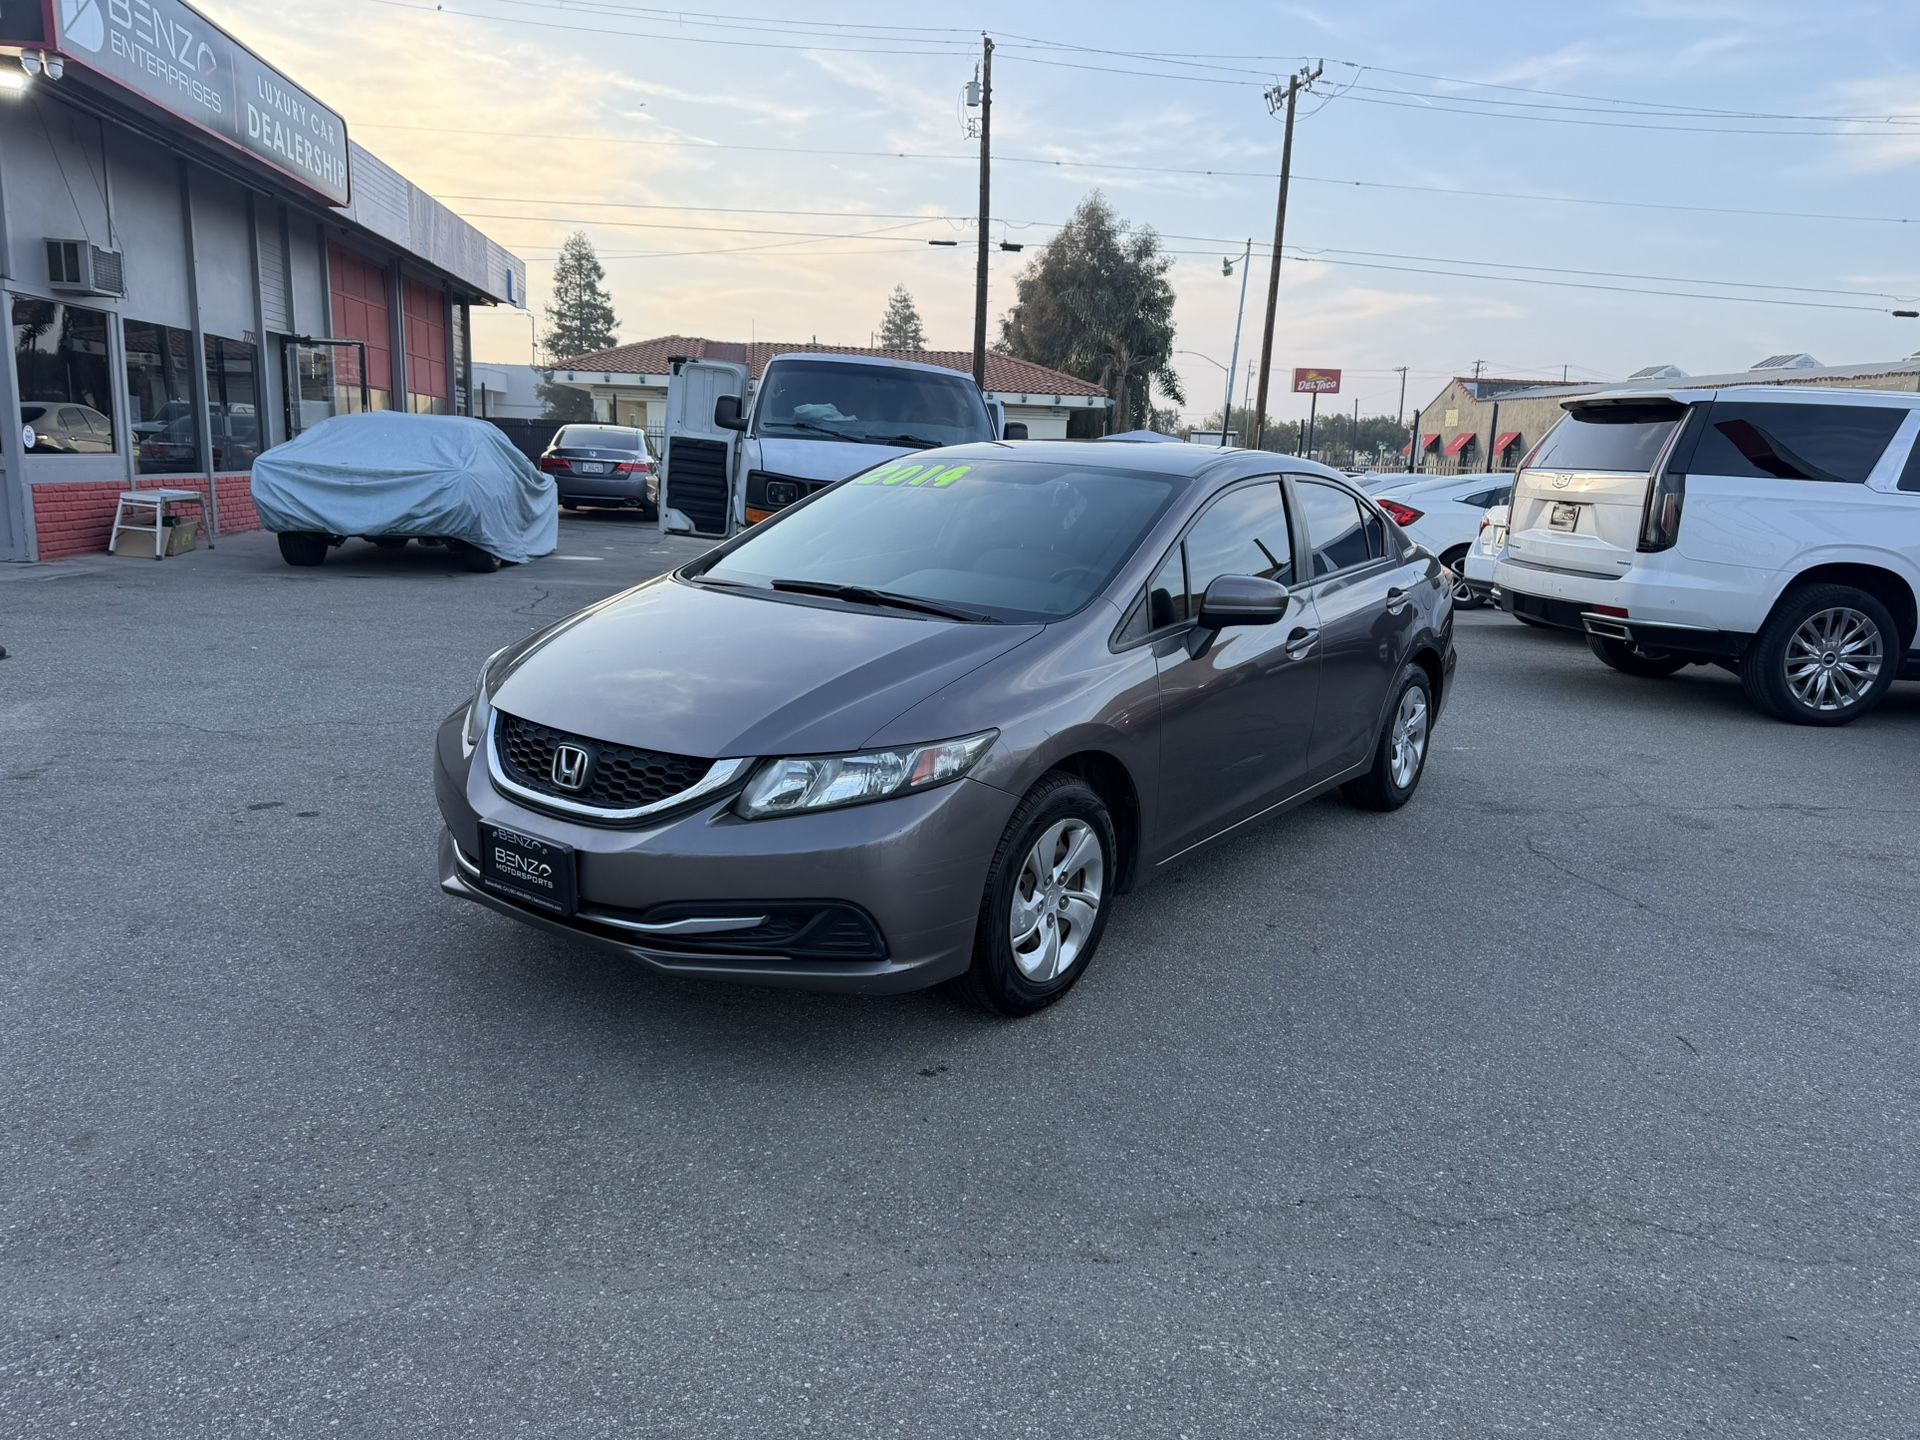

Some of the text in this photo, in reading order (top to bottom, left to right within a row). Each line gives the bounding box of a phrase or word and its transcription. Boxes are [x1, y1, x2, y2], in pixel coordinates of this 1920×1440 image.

[110, 28, 222, 113] ENTERPRISES
[257, 75, 335, 145] LUXURY CAR
[247, 102, 345, 188] DEALERSHIP
[856, 464, 972, 488] 2014
[498, 828, 542, 850] BENZO
[495, 847, 552, 877] BENZO
[496, 862, 553, 889] MOTORSPORTS
